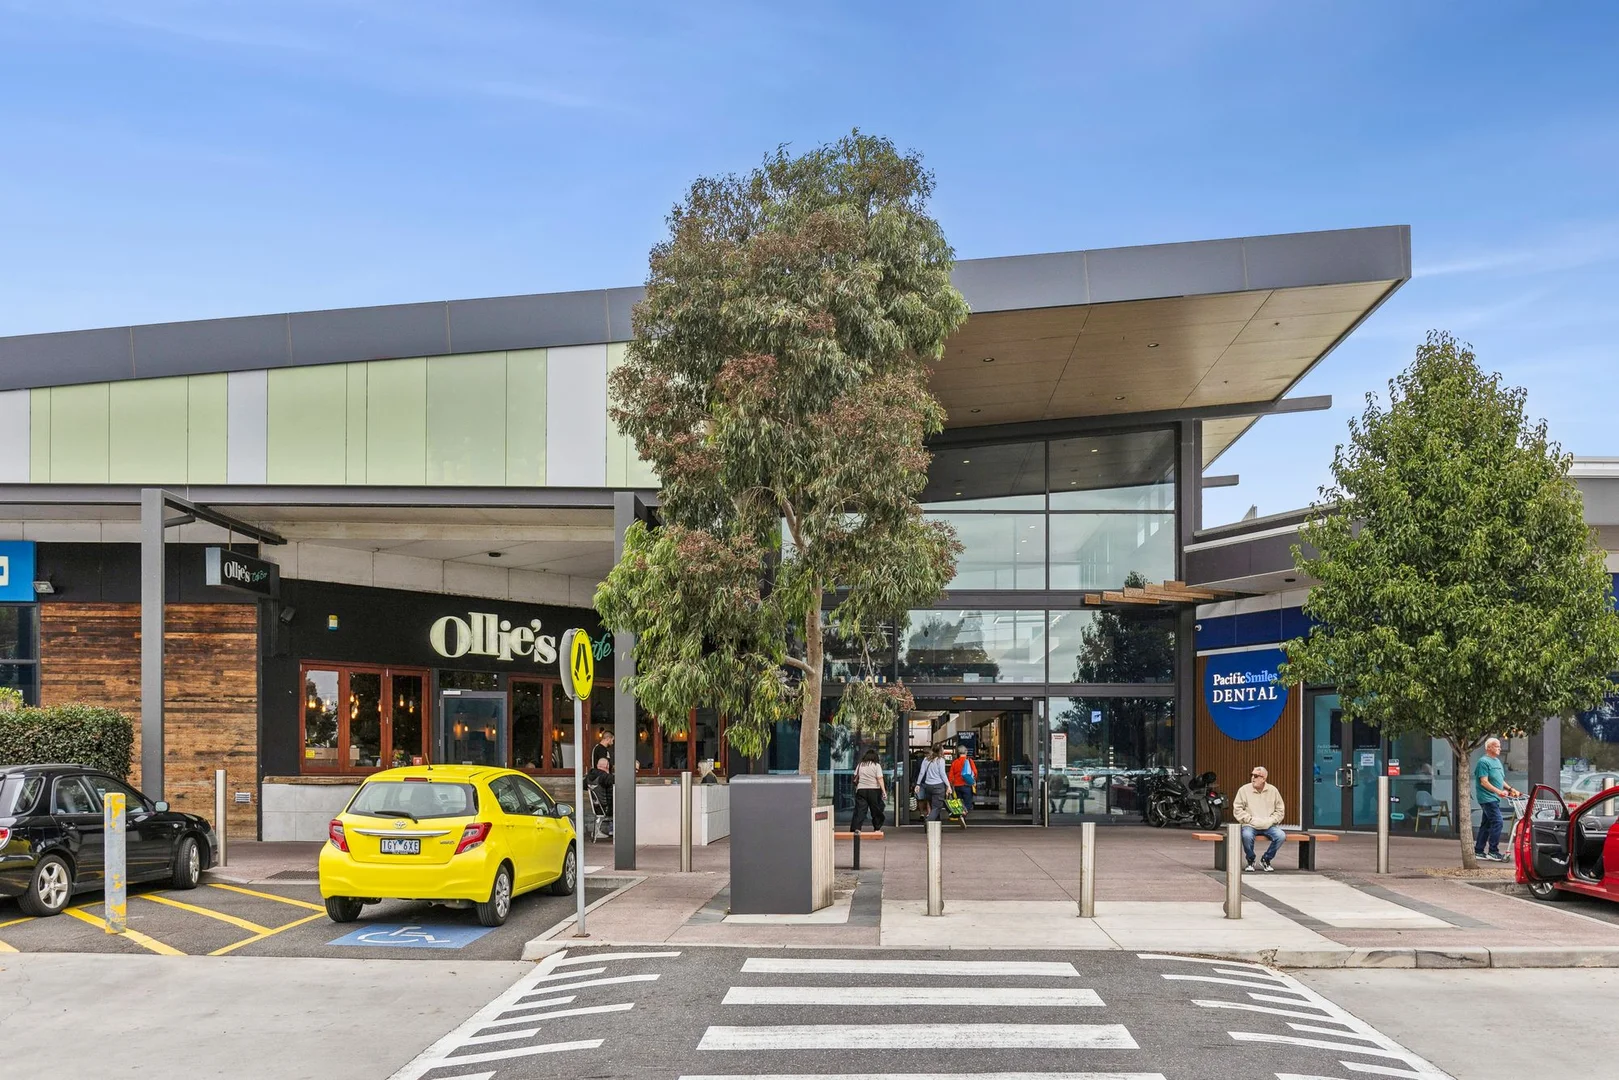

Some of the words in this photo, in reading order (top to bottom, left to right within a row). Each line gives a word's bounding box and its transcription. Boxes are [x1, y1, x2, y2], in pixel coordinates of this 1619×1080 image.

[224, 561, 250, 582] Ollie's
[430, 612, 557, 664] Ollie's
[1213, 670, 1277, 686] PacificSmiles
[1213, 686, 1278, 703] DENTAL
